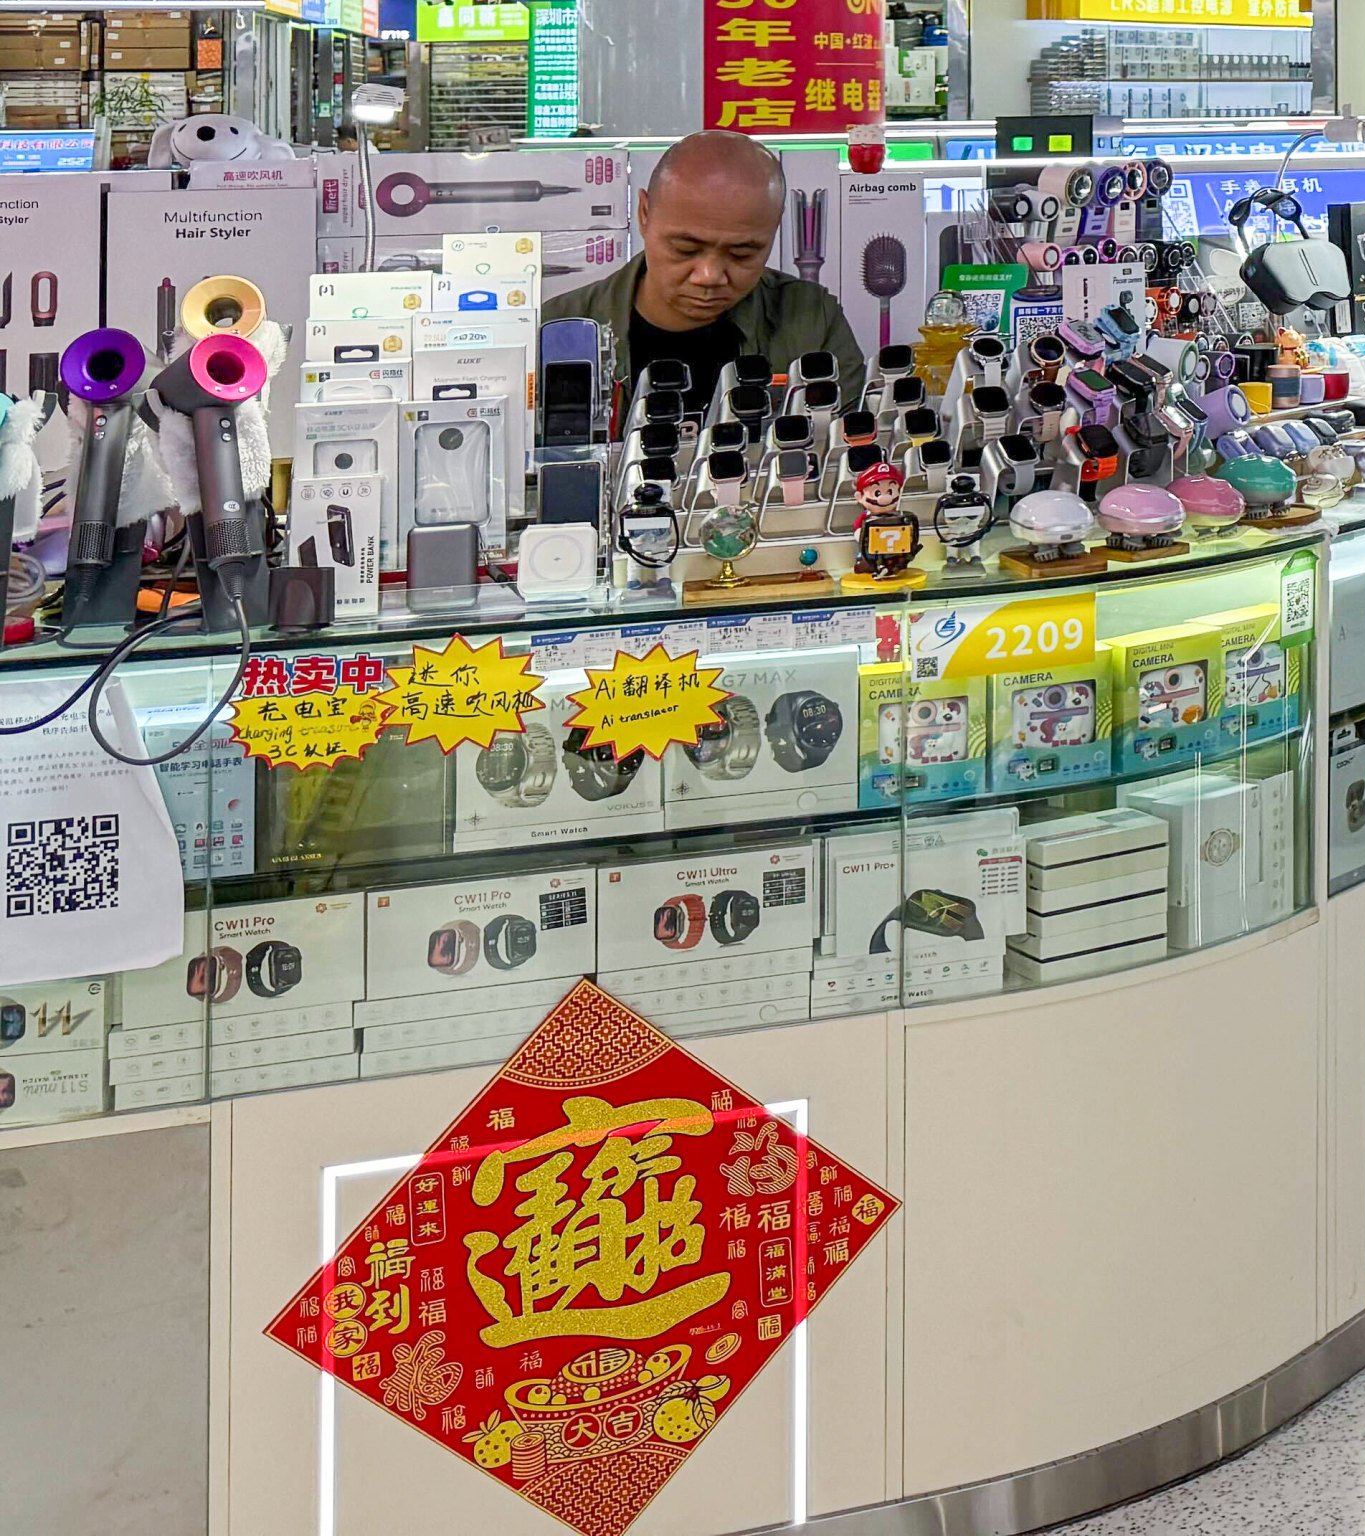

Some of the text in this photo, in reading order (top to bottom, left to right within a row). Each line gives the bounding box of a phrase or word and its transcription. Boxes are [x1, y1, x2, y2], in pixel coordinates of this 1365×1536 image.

[223, 169, 283, 182] 高速吹风机
[848, 182, 916, 194] Airbag comb
[164, 210, 263, 224] Multifunction
[175, 227, 206, 239] Hair
[210, 226, 251, 240] Styler
[985, 617, 1084, 661] 2209
[1132, 652, 1175, 669] CAMERA
[242, 655, 389, 698] 热卖中
[407, 664, 481, 688] 迷你
[754, 669, 797, 686] MAX
[1002, 670, 1054, 686] CAMERA
[596, 673, 699, 700] Ai 翻译机
[868, 684, 921, 701] CAMERA
[803, 703, 827, 718] 08:30
[676, 865, 738, 881] CW11 Ultra
[842, 861, 895, 875] CW11 Pro+
[454, 890, 512, 906] CW11 Pro
[458, 902, 507, 912] Smart Watch
[214, 915, 276, 932] CW11 Pro
[219, 926, 272, 939] Smart Watch
